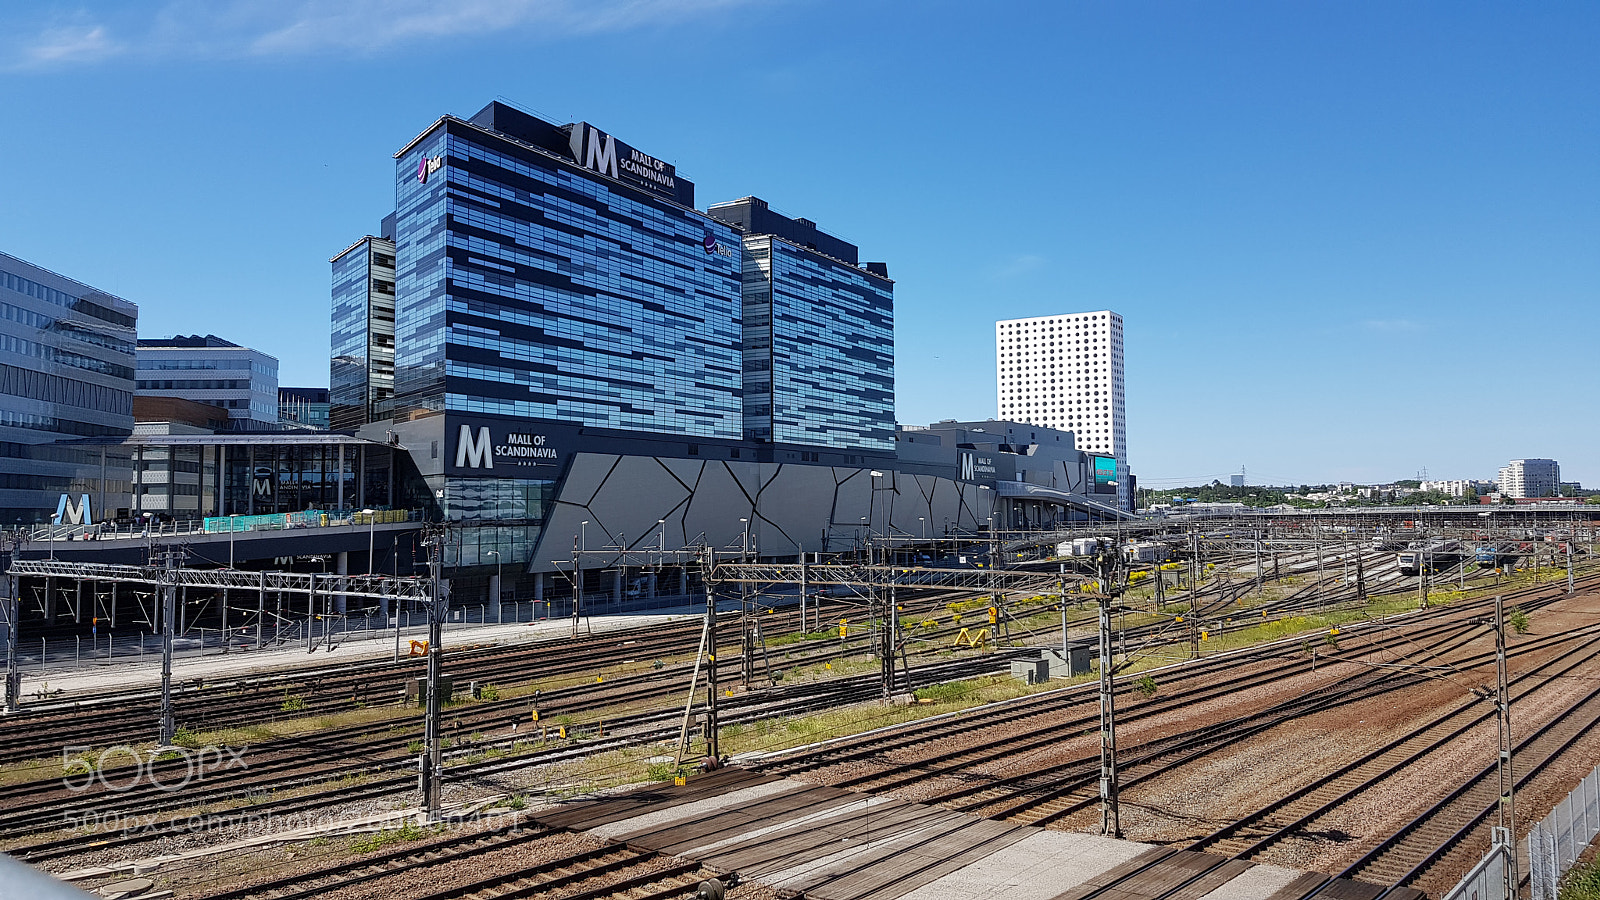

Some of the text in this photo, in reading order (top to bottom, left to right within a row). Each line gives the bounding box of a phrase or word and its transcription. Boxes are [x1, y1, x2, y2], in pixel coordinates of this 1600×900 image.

[585, 127, 619, 180] M
[631, 149, 665, 173] MALL OF
[427, 155, 441, 174] Telia
[620, 158, 675, 189] SCANDINAVIA
[716, 243, 732, 258] Telia
[456, 424, 494, 469] M
[508, 433, 546, 446] MALL OF
[495, 445, 558, 459] SCANDINAVIA
[961, 452, 975, 481] M
[253, 478, 271, 496] M
